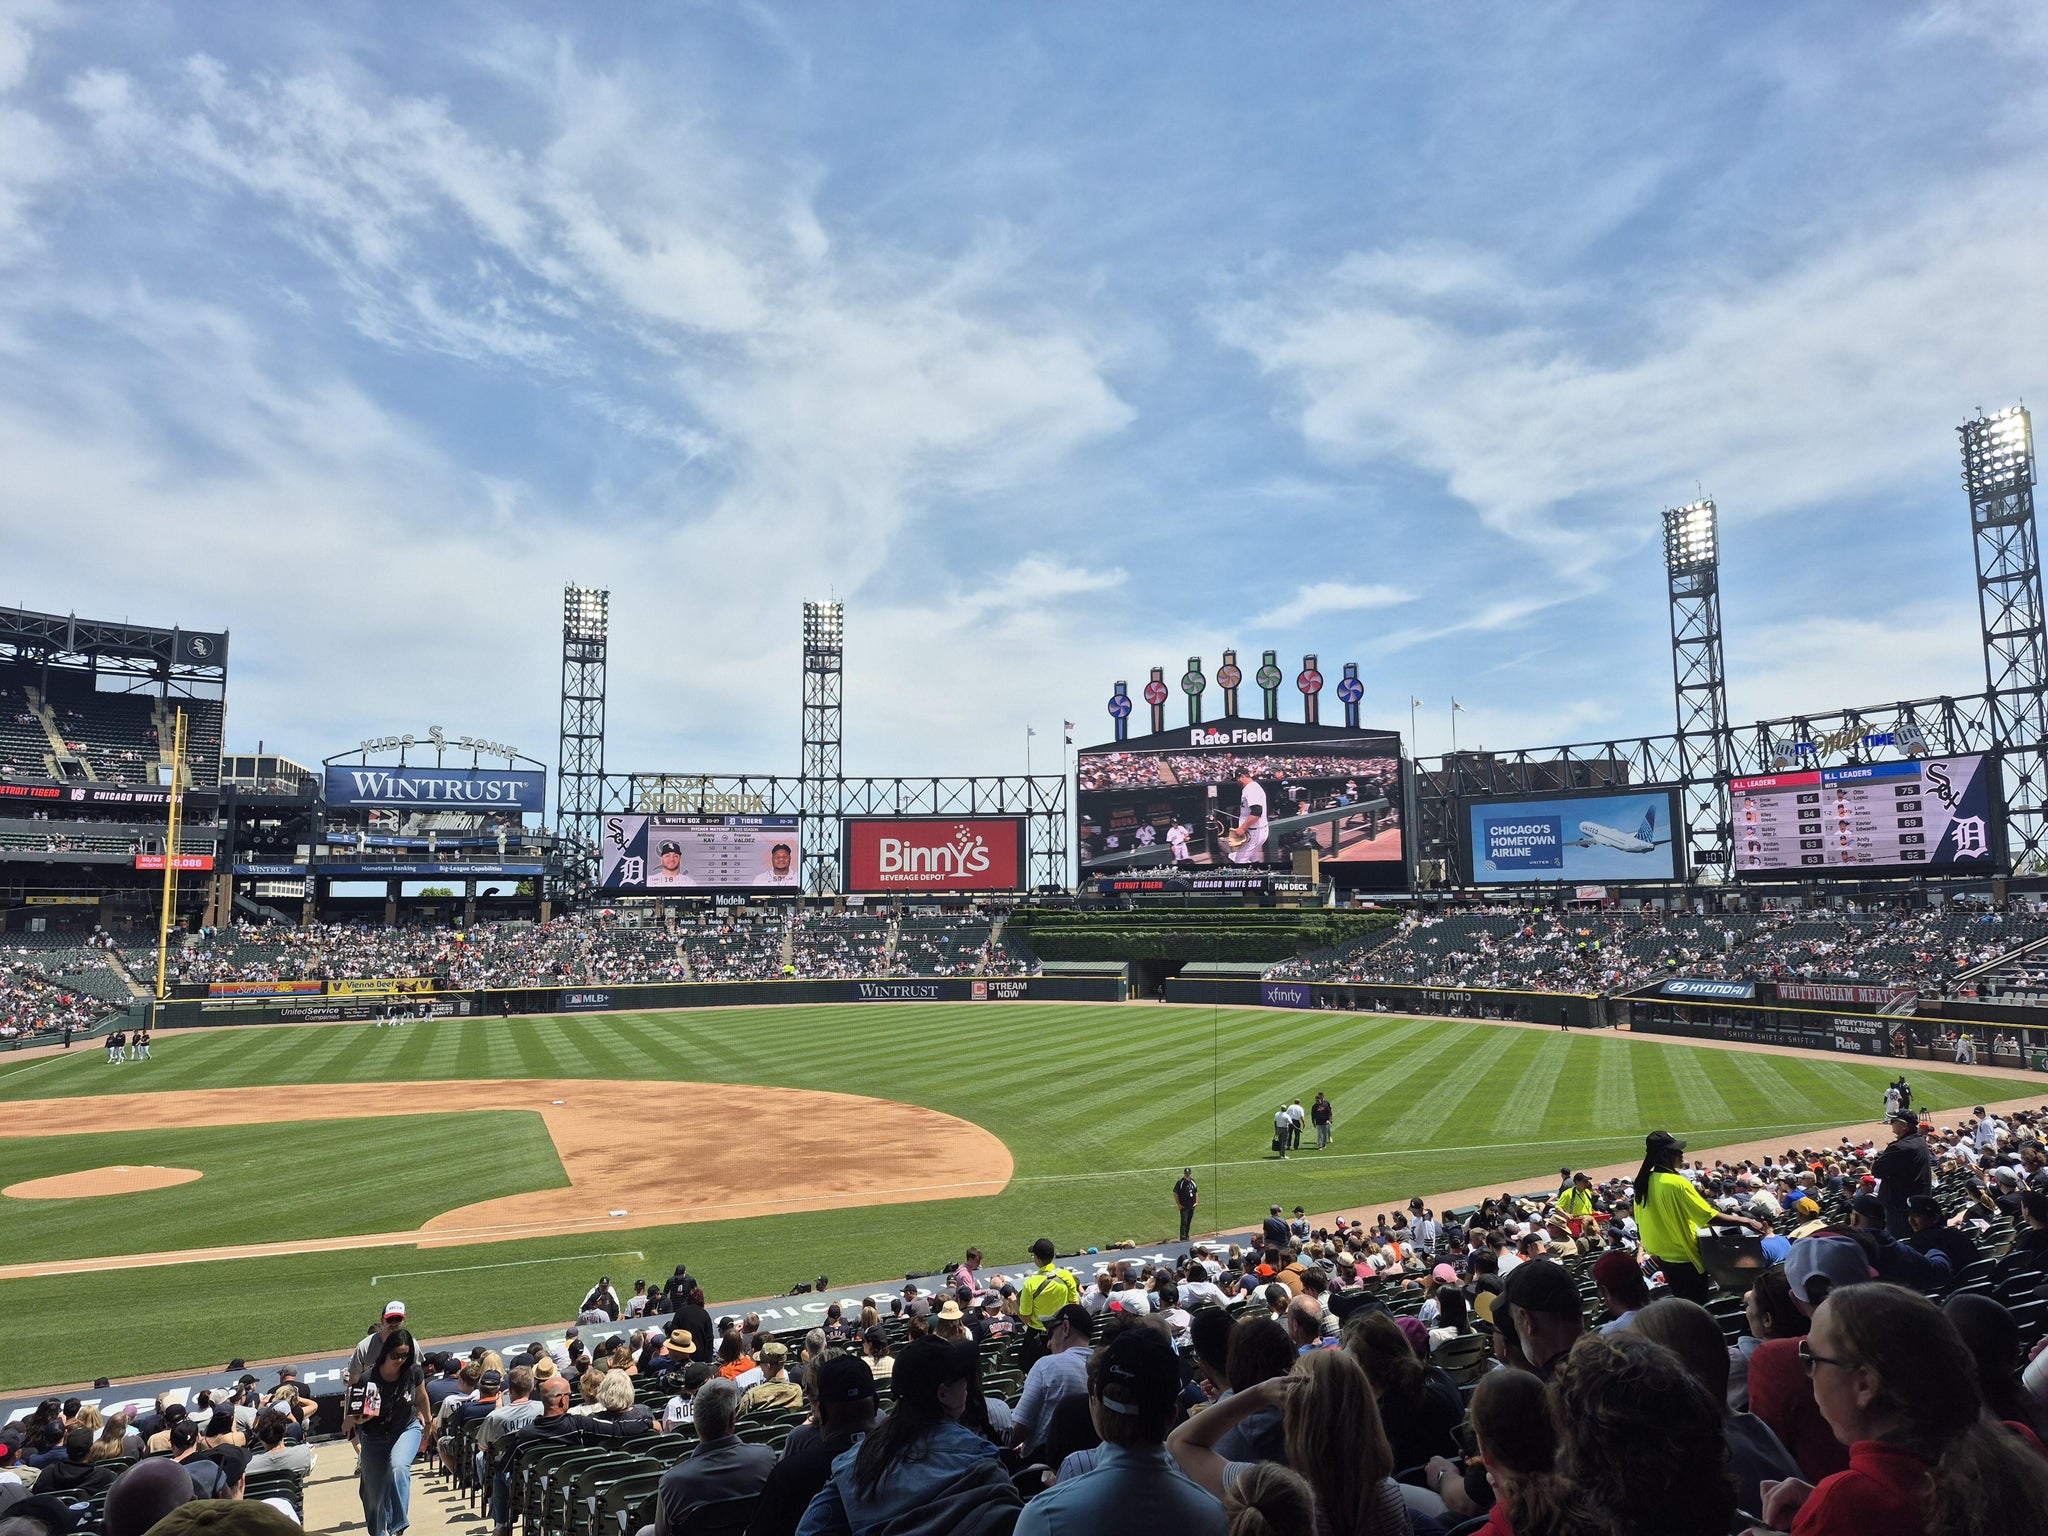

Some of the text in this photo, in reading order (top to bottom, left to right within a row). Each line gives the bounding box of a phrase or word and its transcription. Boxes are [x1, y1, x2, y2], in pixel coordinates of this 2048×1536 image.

[1191, 727, 1273, 746] Rate Field
[1812, 723, 1877, 759] Miller
[1863, 733, 1895, 747] TIME
[1897, 728, 1920, 746] Lite
[360, 734, 415, 755] KIDS
[458, 736, 518, 760] ZONE
[1776, 744, 1795, 757] Lite
[1840, 769, 1872, 778] LEADERS
[351, 771, 524, 801] WINTRUST
[640, 777, 715, 789] CAESARS
[1747, 779, 1776, 787] LEADERS
[30, 787, 60, 797] TIGERS
[71, 788, 86, 801] VS
[1901, 787, 1914, 795] 75
[93, 791, 133, 801] CHICAGO
[135, 793, 164, 803] WHITE
[640, 793, 765, 813] SPORTSBOOK
[1903, 803, 1915, 811] 69
[1904, 819, 1916, 827] 69
[1490, 824, 1551, 836] CHICAGO'S
[1490, 835, 1555, 847] HOMETOWN
[1905, 835, 1917, 843] 63
[1491, 847, 1532, 858] AIRLINE
[1705, 852, 1724, 862] 1:07
[249, 866, 292, 874] WINTRUST
[1114, 880, 1262, 889] DETROIT TIGERS CHICAGO WHITE SOX
[715, 894, 745, 905] Modelo
[236, 984, 274, 995] Surfside
[346, 981, 375, 989] Vienna
[858, 983, 938, 998] WINTRUST
[988, 982, 1027, 990] STREAM
[1688, 983, 1746, 995] HYUNDAI
[997, 989, 1019, 998] NOW
[1267, 987, 1302, 1004] xfinity
[1422, 991, 1441, 1000] THE
[1779, 985, 1896, 1003] WHITTINGHAM MEATS
[1834, 1018, 1883, 1029] EVERYTHING
[1834, 1025, 1877, 1035] WELLNESS
[1835, 1036, 1861, 1051] Rate
